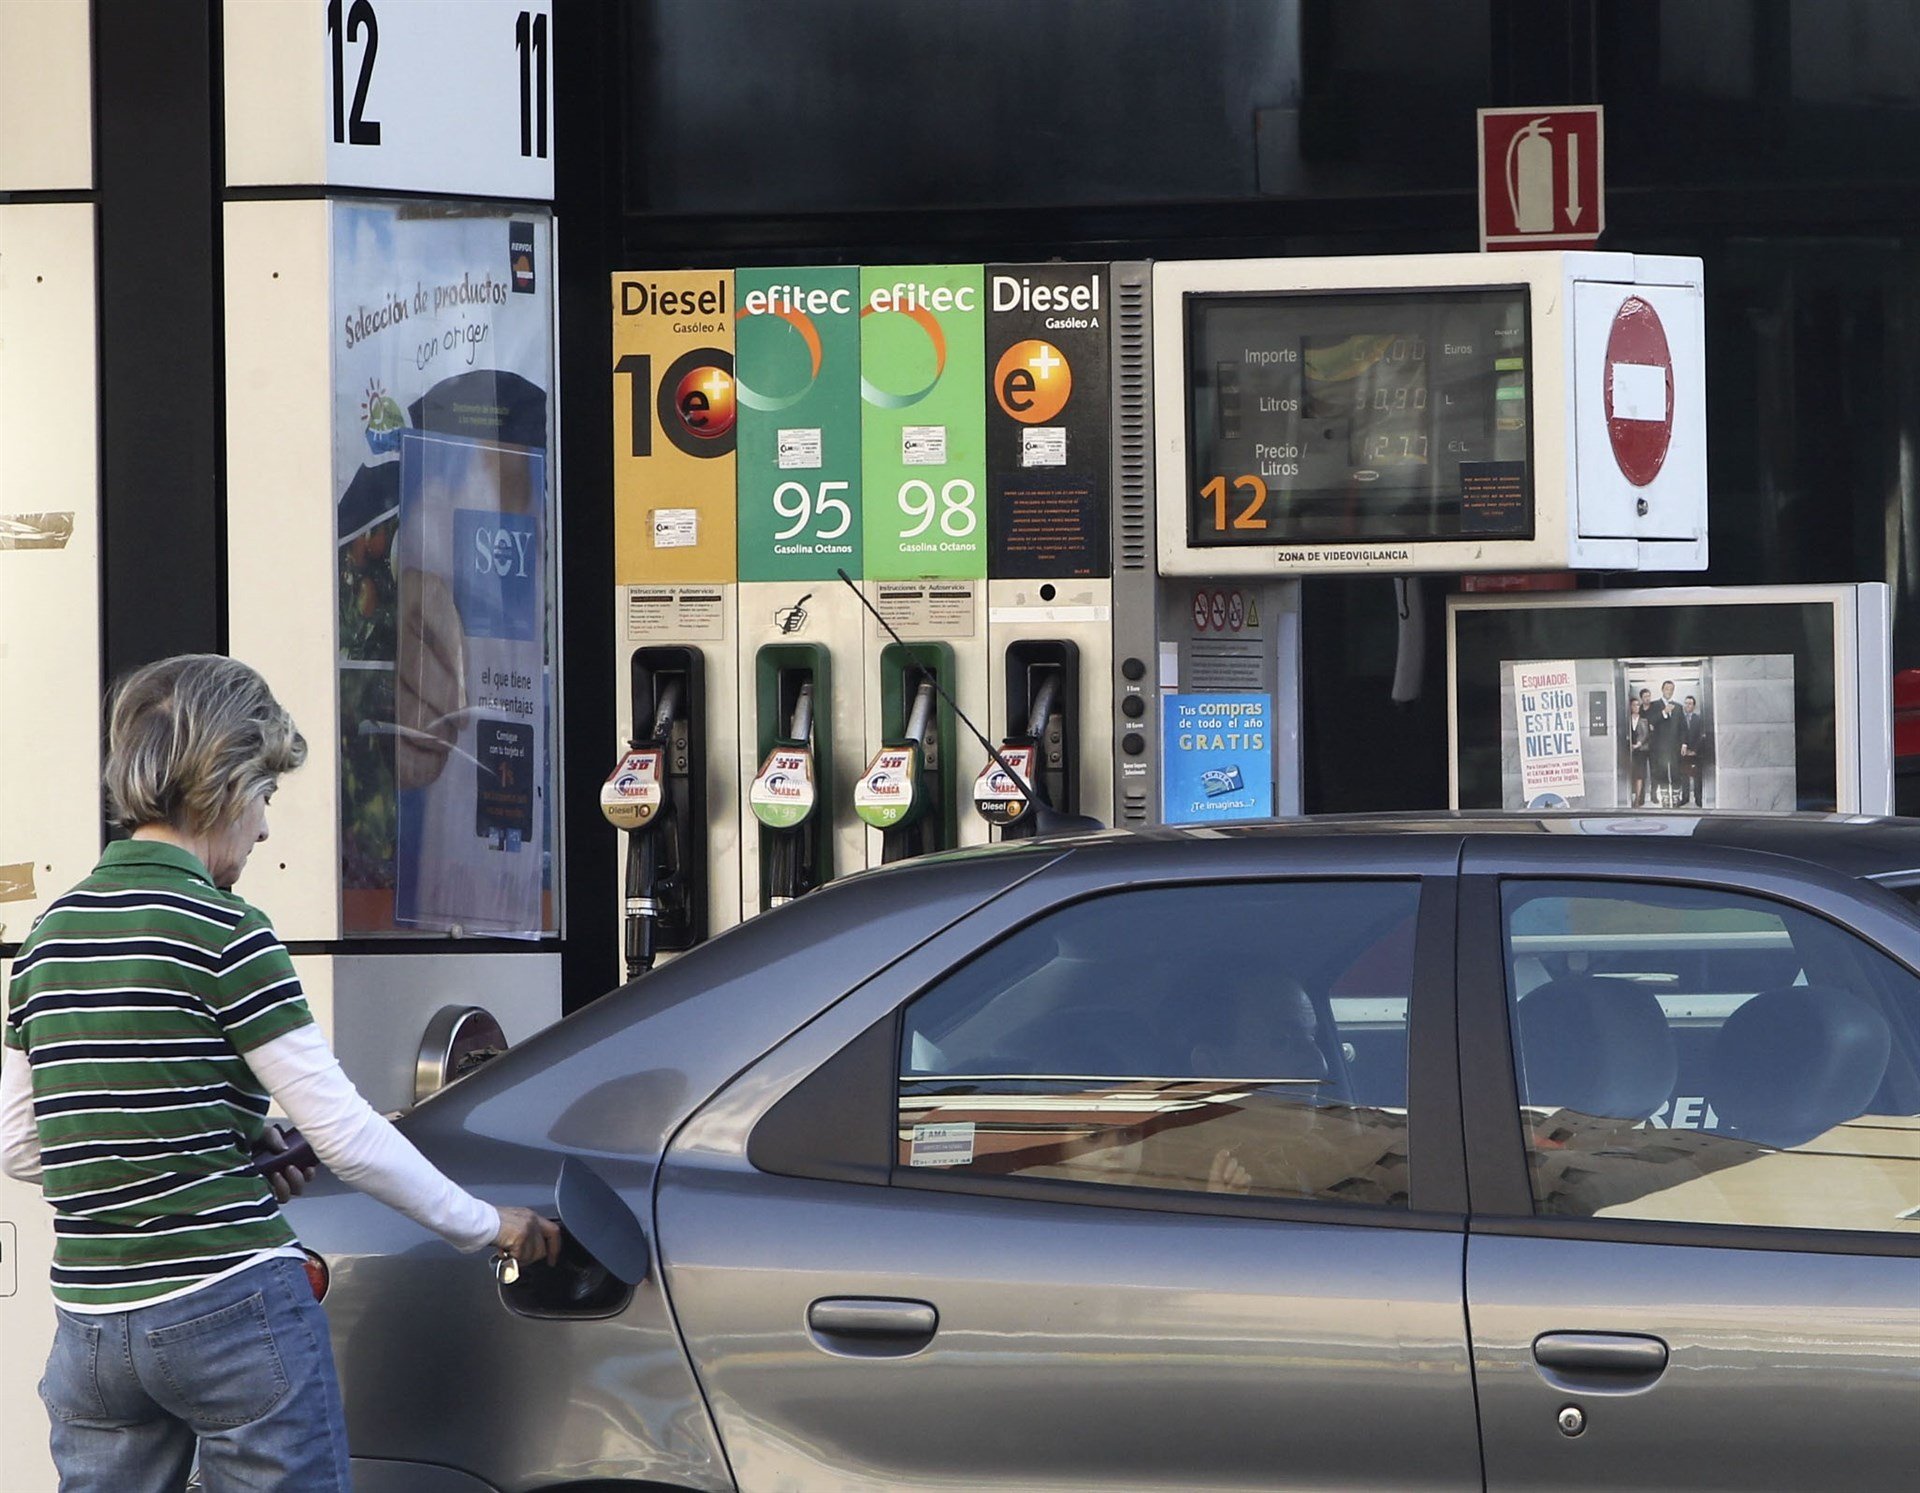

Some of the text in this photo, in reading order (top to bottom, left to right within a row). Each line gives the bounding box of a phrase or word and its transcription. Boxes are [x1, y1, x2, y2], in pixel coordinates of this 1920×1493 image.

[327, 0, 381, 146] 12
[515, 11, 548, 159] 11
[620, 280, 725, 316] Diesel
[745, 285, 851, 316] efitec
[869, 282, 975, 313] efitec
[992, 275, 1100, 313] Diesel
[345, 271, 508, 350] Selección de productos
[673, 321, 726, 334] Gasóleo A
[1045, 317, 1099, 330] Gasóleo A
[417, 313, 489, 371] con origen
[1444, 343, 1472, 355] Euros
[1245, 348, 1298, 366] Importe
[1259, 396, 1298, 412] Litros
[1255, 443, 1299, 459] Precio
[1261, 460, 1299, 476] Litros
[772, 481, 852, 540] 95
[897, 479, 977, 538] 98
[1200, 474, 1267, 531] 12
[774, 543, 853, 554] Gasolina Octanos
[899, 541, 976, 553] Gasolina Octanos
[1278, 550, 1409, 562] ZONA DE VIDEOVIGILANCIA
[630, 587, 667, 595] Instrucciones
[678, 587, 715, 595] Autoservicio
[879, 584, 916, 592] Instrucciones
[481, 667, 532, 691] el que tiene
[1521, 673, 1570, 689] ESQUIADOR:
[1521, 689, 1574, 712] tu Sitio
[1179, 703, 1263, 719] Tus compras
[1179, 718, 1263, 729] de todo el año
[1566, 720, 1575, 731] la
[1179, 733, 1264, 751] GRATIS
[1525, 733, 1579, 758] NIEVE.
[608, 804, 651, 818] Diesel 10
[882, 808, 897, 819] 98
[981, 801, 1007, 811] Diesel
[1190, 801, 1205, 813] ¿Te
